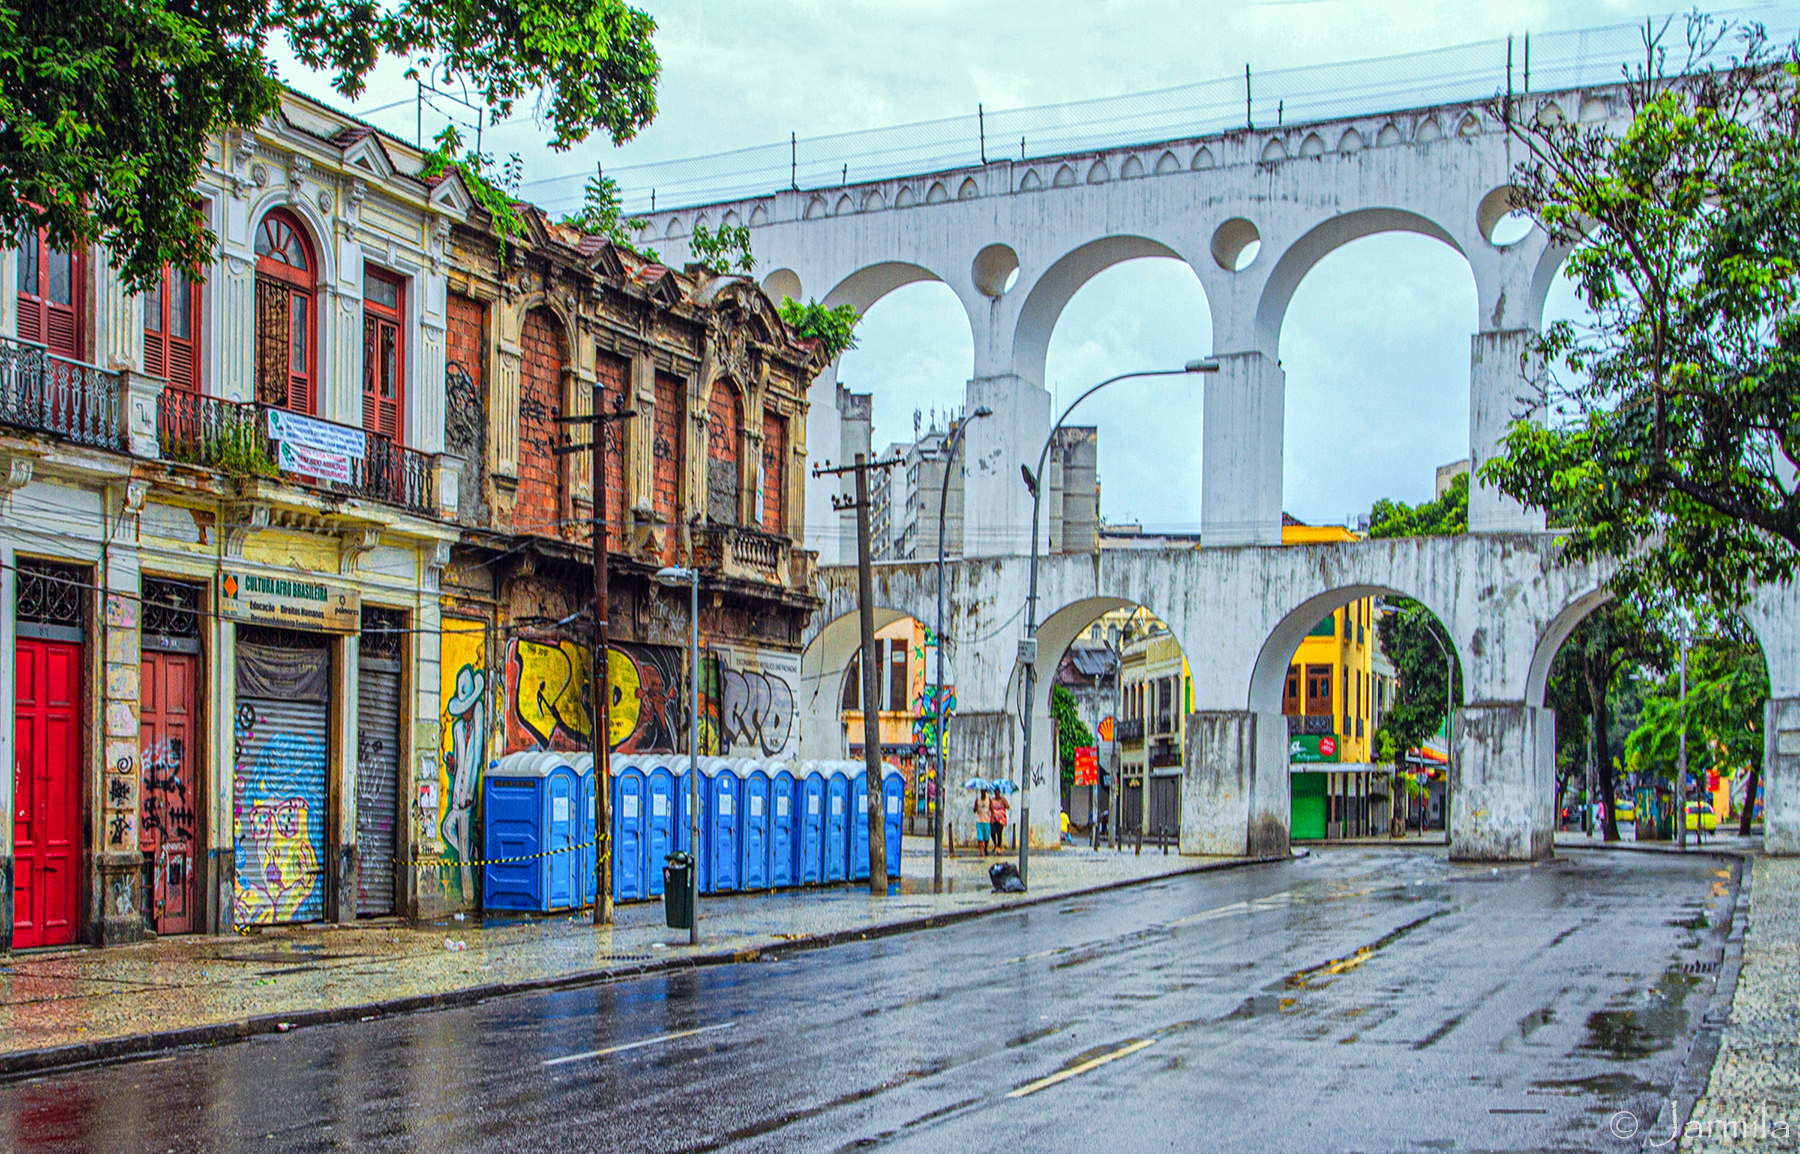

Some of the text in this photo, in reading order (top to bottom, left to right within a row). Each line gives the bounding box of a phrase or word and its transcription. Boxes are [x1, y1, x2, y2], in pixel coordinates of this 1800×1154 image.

[244, 575, 328, 602] CULTURA AFRO BRASILEIRA
[249, 600, 276, 613] Educação
[280, 604, 300, 616] Direitos
